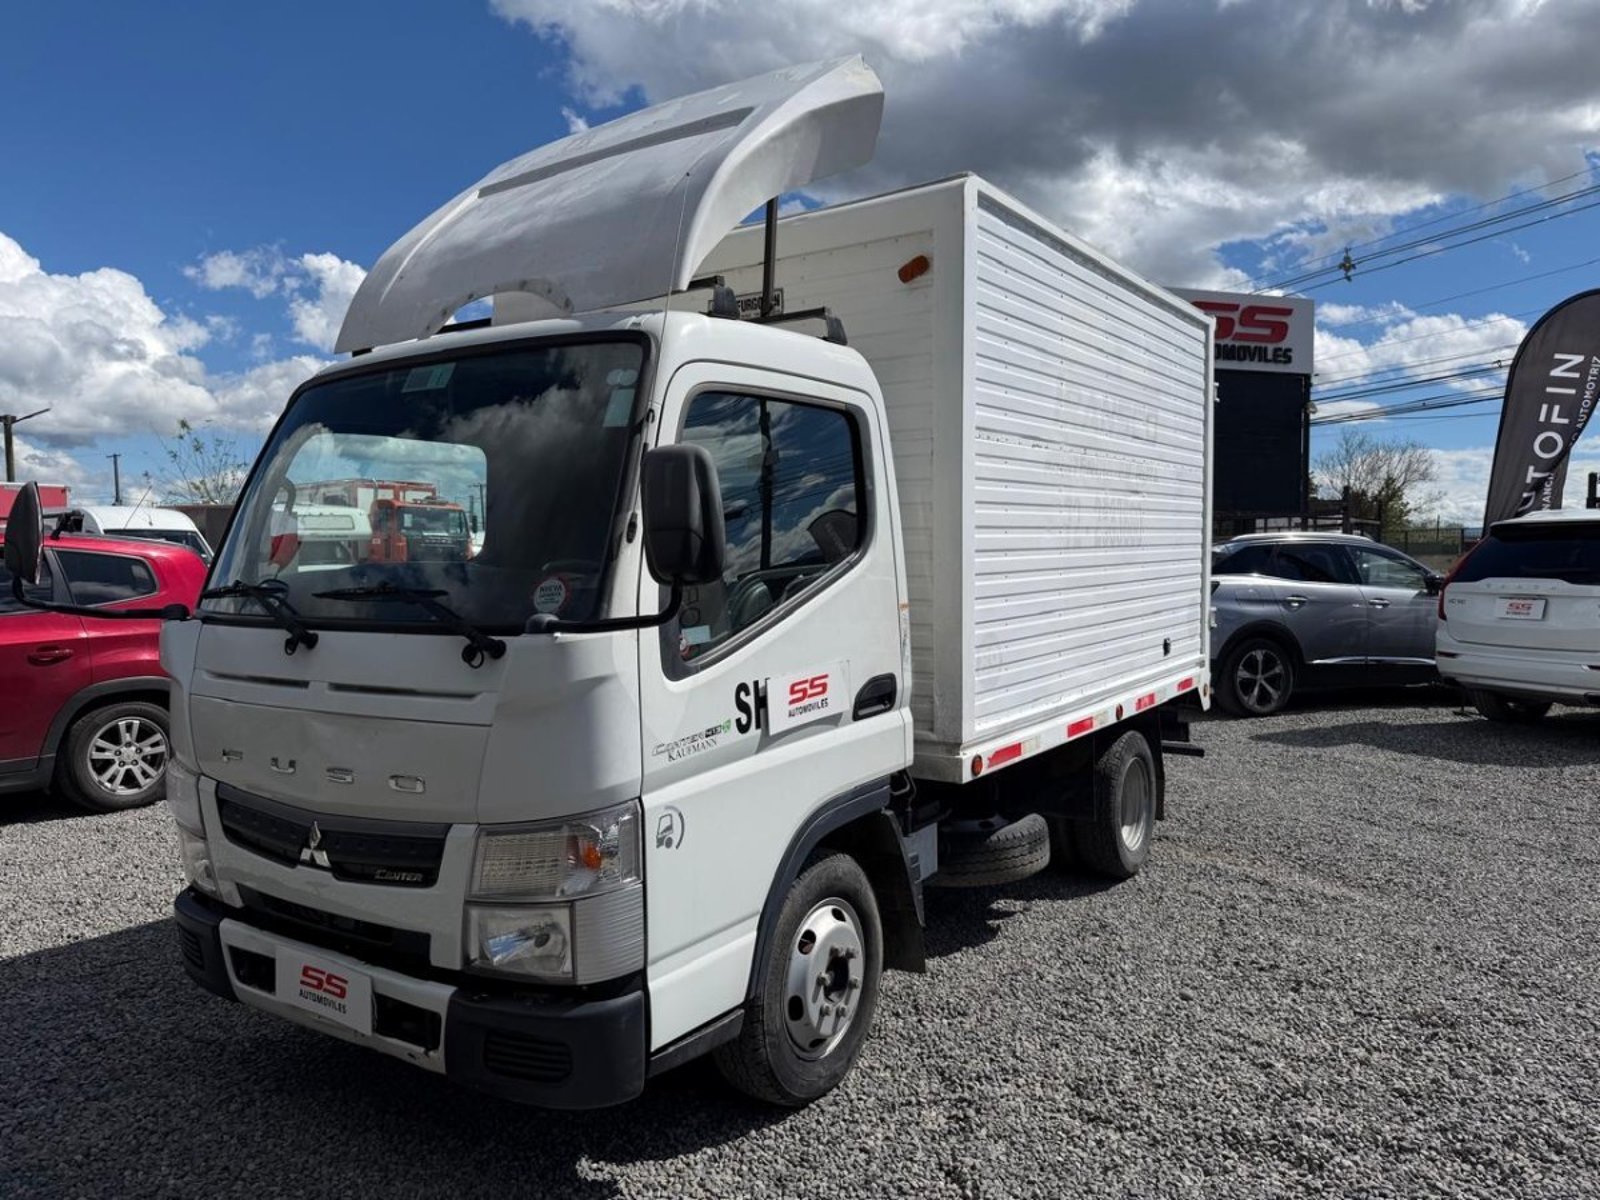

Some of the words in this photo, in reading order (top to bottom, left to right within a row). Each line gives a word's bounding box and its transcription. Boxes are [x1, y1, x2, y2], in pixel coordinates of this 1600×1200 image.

[1518, 353, 1585, 511] UTOFIN
[788, 674, 829, 705] SS
[788, 697, 829, 718] AUTOMOVILES
[222, 748, 426, 794] FUSO
[375, 868, 424, 883] CANTER
[300, 965, 349, 1000] SS
[299, 988, 347, 1015] AUTOMOVILES
